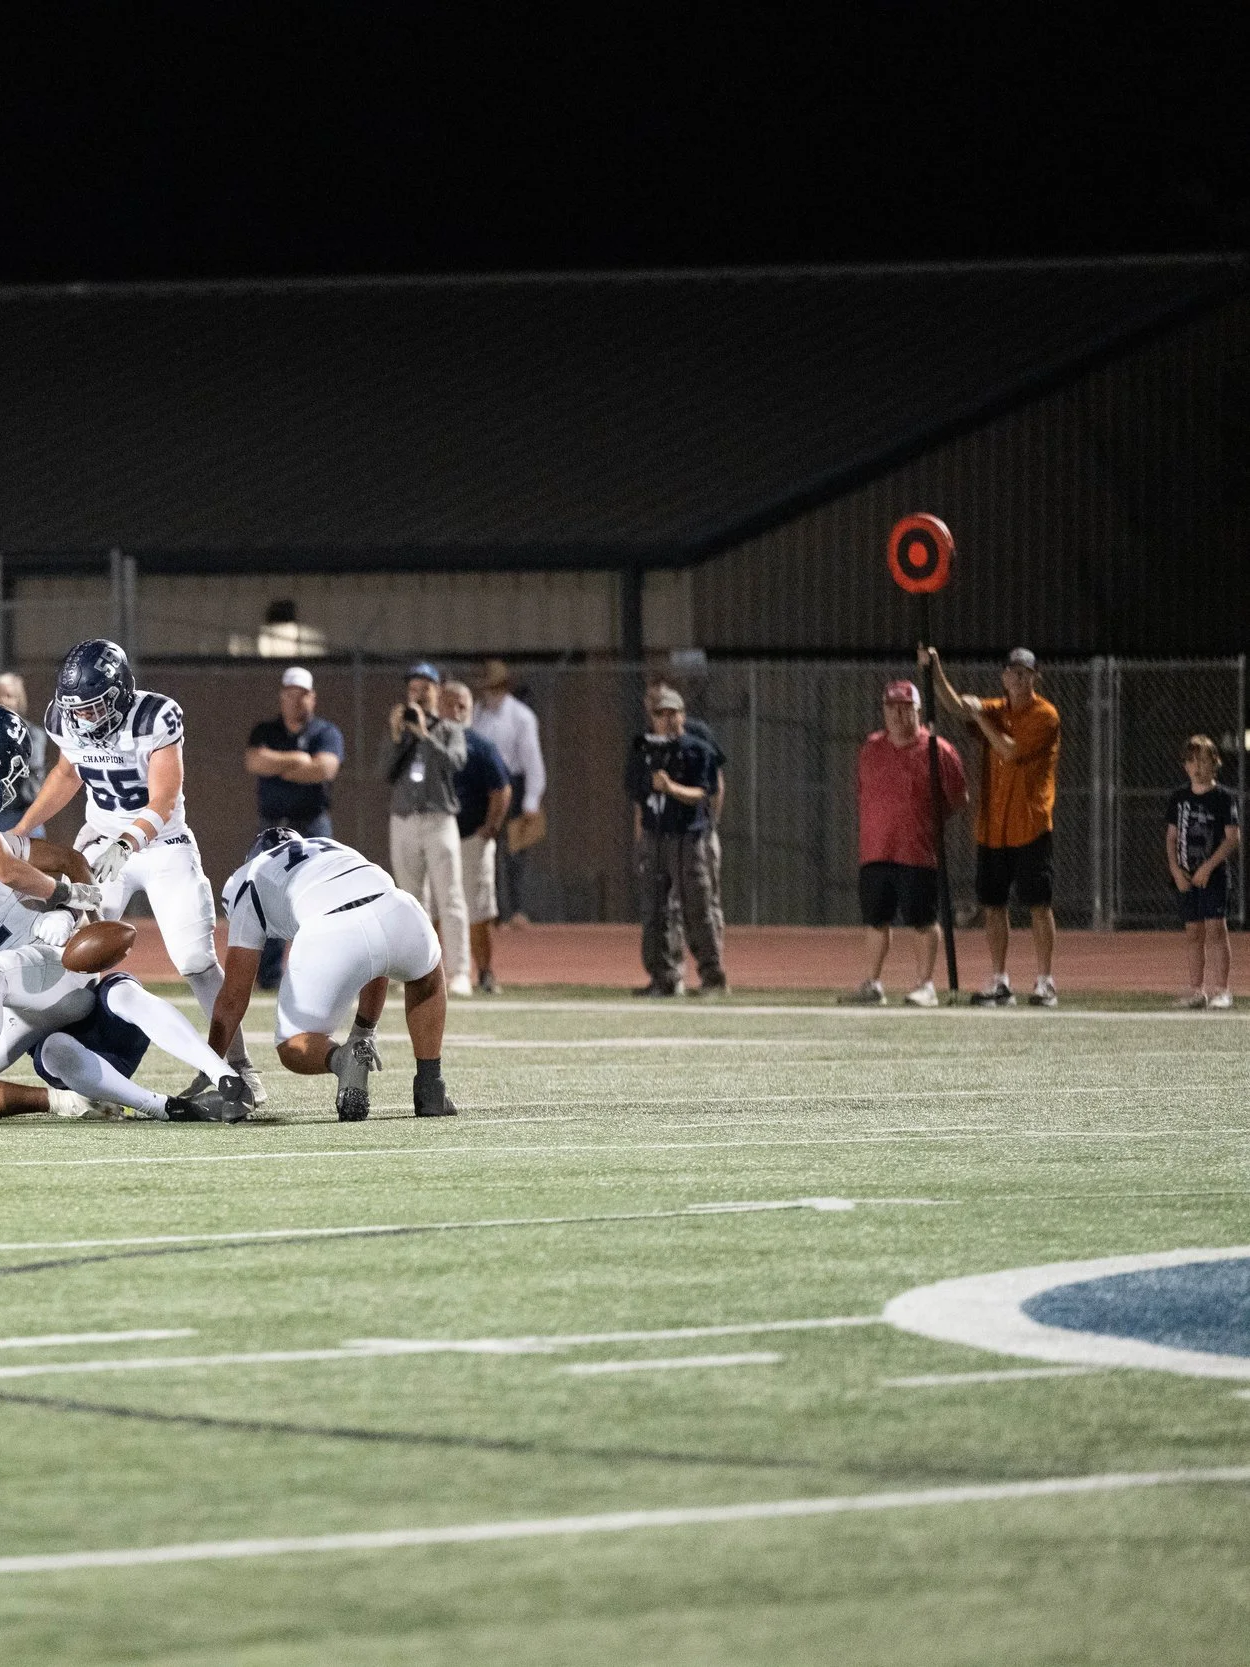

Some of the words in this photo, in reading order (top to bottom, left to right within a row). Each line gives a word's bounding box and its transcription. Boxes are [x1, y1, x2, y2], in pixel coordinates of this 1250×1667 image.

[6, 713, 27, 744] 31
[83, 755, 124, 764] CHAMPION
[78, 764, 150, 812] 55
